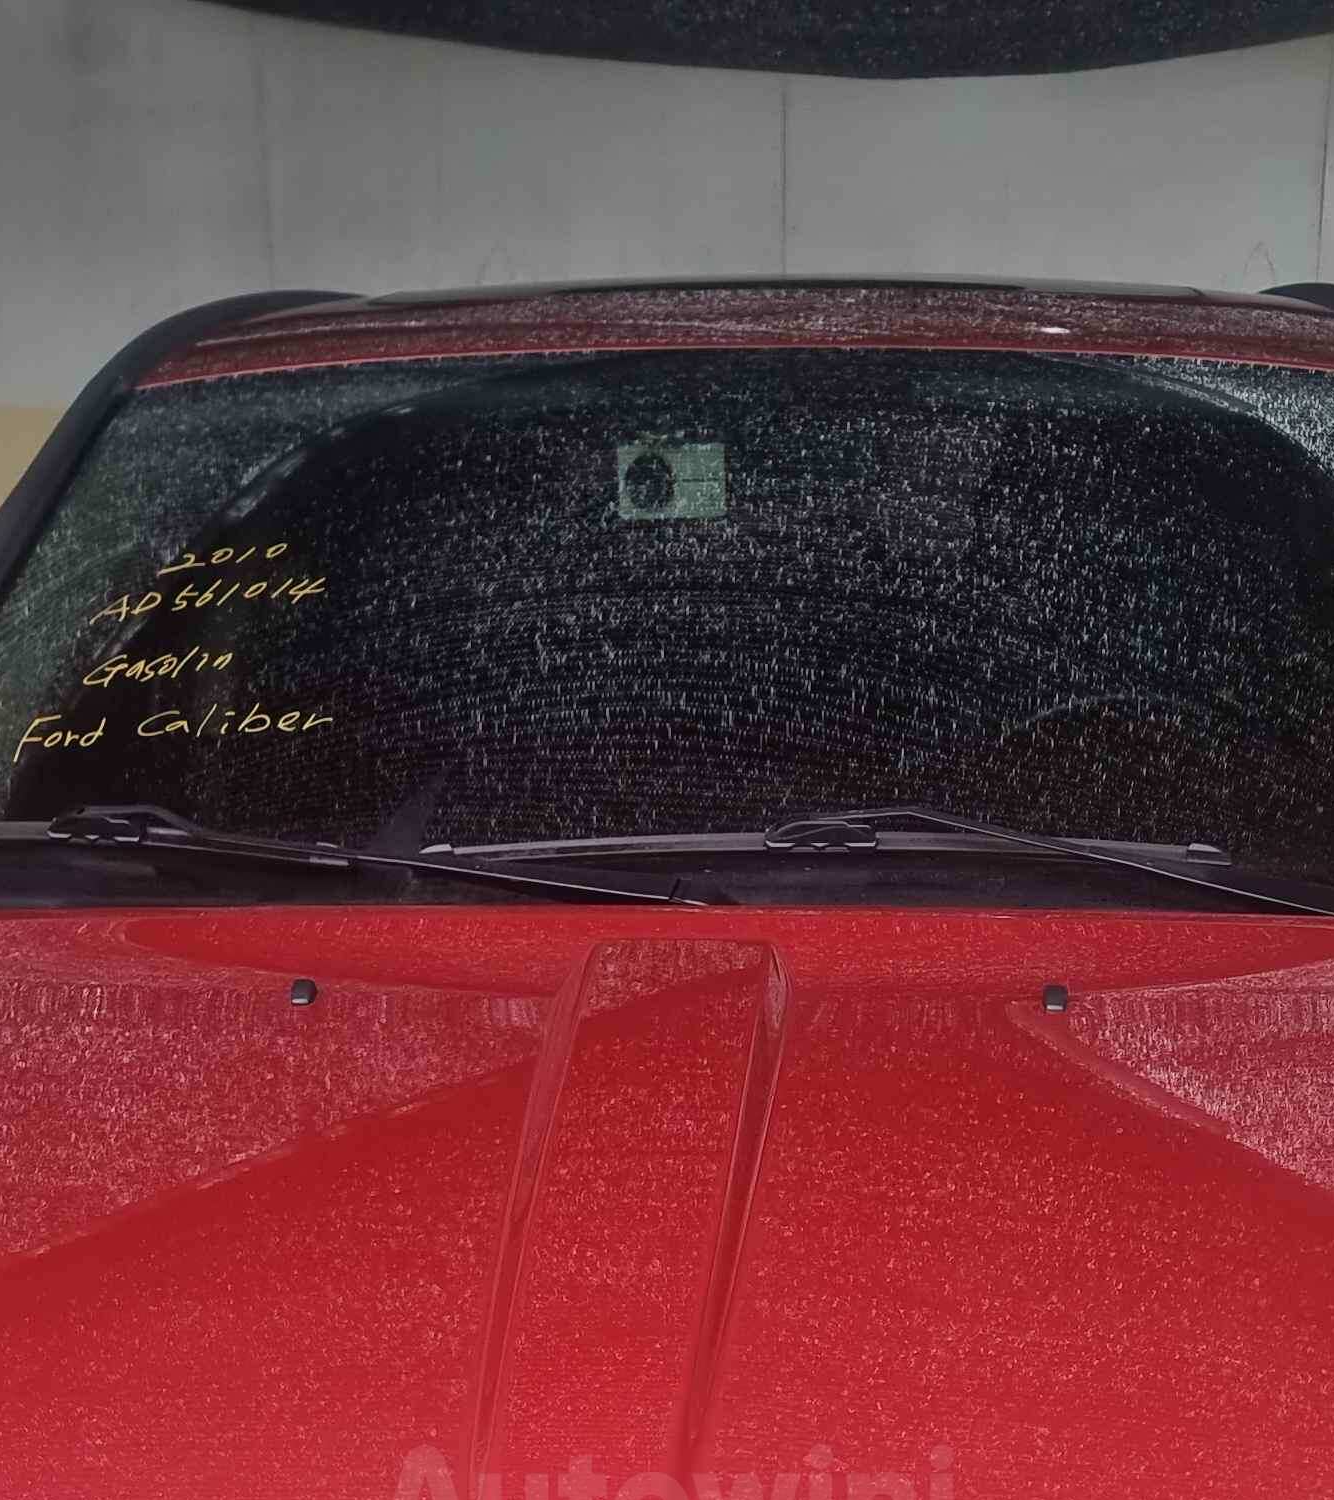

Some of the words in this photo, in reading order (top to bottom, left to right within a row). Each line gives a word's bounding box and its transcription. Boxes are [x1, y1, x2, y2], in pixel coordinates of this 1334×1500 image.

[157, 543, 287, 576] 2010
[14, 714, 107, 763] Ford
[137, 703, 333, 738] Caliber
